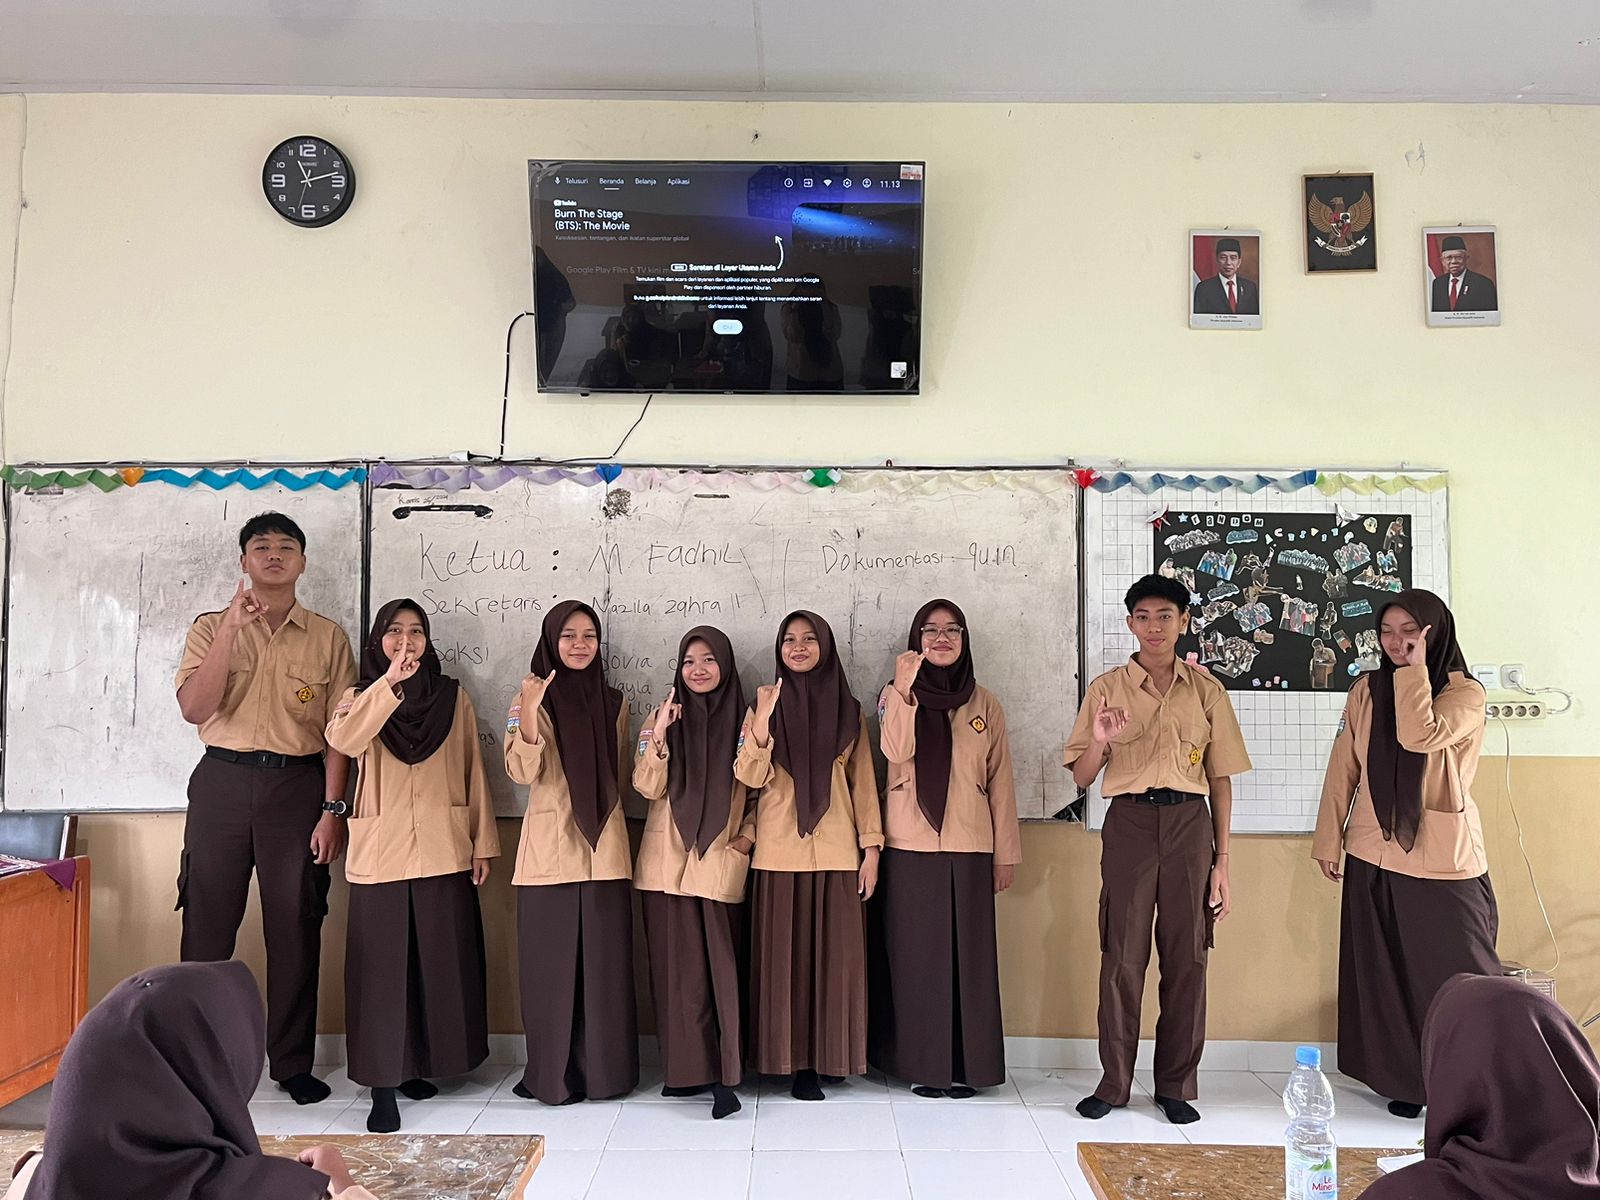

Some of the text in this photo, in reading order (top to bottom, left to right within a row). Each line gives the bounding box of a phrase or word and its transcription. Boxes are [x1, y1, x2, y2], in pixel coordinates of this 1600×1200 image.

[299, 144, 317, 157] 12
[276, 161, 286, 169] 10
[333, 160, 340, 168] 2
[271, 174, 286, 188] 9
[331, 175, 345, 188] 3
[565, 177, 901, 189] Telusuri Beranda Belanja Aplikasi 11.13
[278, 194, 287, 202] 8
[333, 193, 340, 201] 4
[301, 204, 316, 218] 6
[554, 208, 624, 220] Burn The Stage
[555, 221, 631, 231] (BTS): The Movie
[566, 265, 594, 275] Google
[595, 266, 611, 275] Play
[612, 266, 629, 274] Film
[637, 266, 647, 274] TV
[420, 532, 531, 582] Ketua
[822, 544, 945, 575] Dokumentasi
[421, 588, 542, 617] Sekretaris
[1324, 1176, 1332, 1184] Le
